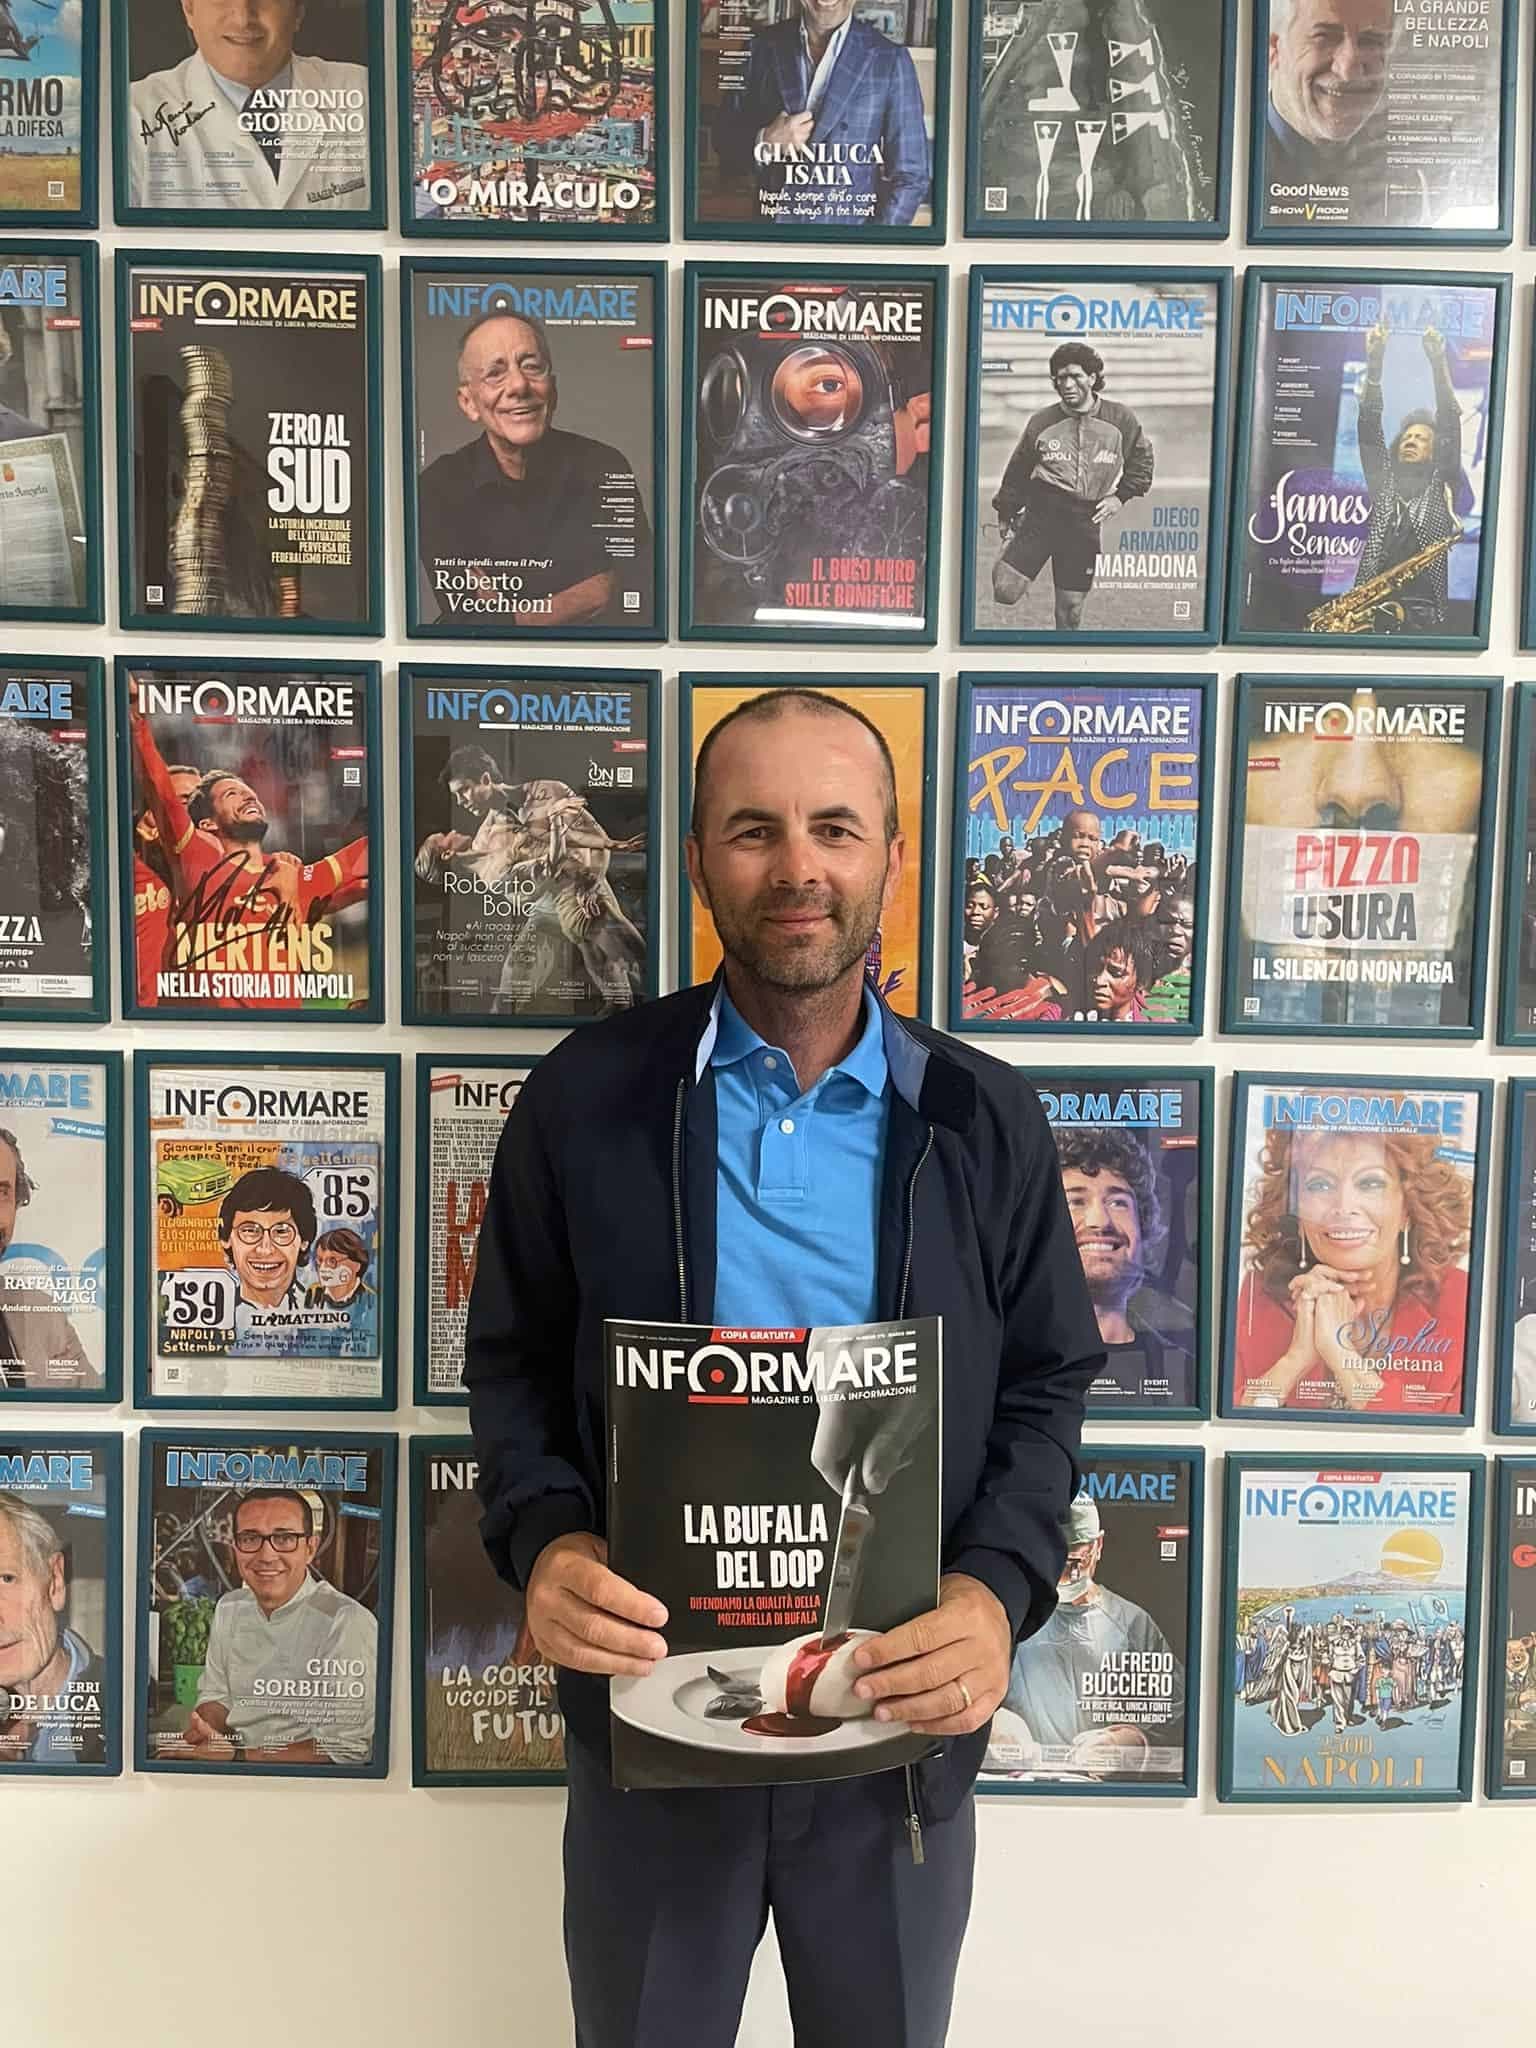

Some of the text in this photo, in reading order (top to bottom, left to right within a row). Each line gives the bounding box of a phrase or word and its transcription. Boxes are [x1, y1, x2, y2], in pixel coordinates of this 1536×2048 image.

[1394, 0, 1489, 15] LA GRANDE
[1405, 18, 1489, 32] BELLEZZA
[1413, 32, 1489, 48] È NAPOLI
[250, 88, 364, 110] ANTONIO
[21, 120, 64, 137] DIFESA
[239, 112, 365, 133] GIORDANO
[754, 143, 885, 165] GIANLUCA
[785, 165, 852, 185] ISAIA
[423, 173, 641, 209] 'O MIRÀCULO
[856, 193, 878, 203] core
[793, 203, 876, 219] always in the heart
[140, 281, 356, 320] INFORMARE
[427, 283, 637, 320] INFORMARE
[704, 294, 923, 333] INFORMARE
[991, 294, 1206, 330] INFORMARE
[1275, 293, 1488, 337] INFORMARE
[268, 412, 350, 446] ZERO AL
[268, 447, 351, 514] SUD
[1153, 507, 1200, 527] DIEGO
[1249, 470, 1372, 544] James
[269, 518, 351, 529] LA STORIA INCREDIBILE
[299, 541, 351, 553] PERVERSA DEL
[1119, 531, 1199, 551] ARMANDO
[1288, 523, 1362, 557] Senese
[272, 552, 352, 564] FEDERALISMO FISCALE
[434, 558, 456, 567] Tutti
[457, 559, 466, 567] in
[494, 560, 518, 568] entra
[520, 559, 527, 567] il
[1095, 554, 1198, 579] MARADONA
[434, 570, 523, 591] Roberto
[812, 557, 916, 583] IL BUCO NERO
[446, 593, 553, 614] Vecchioni
[785, 583, 914, 609] SULLE BONIFICHE
[0, 682, 73, 719] ARE
[138, 681, 353, 717] INFORMARE
[427, 688, 631, 724] INFORMARE
[585, 725, 631, 733] INFORMAZIONE
[976, 700, 1191, 736] INFORMARE
[1264, 702, 1466, 736] INFORMARE
[968, 746, 1199, 833] RACE
[1295, 835, 1421, 889] PIZZO
[443, 872, 536, 895] Roberto
[483, 895, 537, 917] Bolle
[1292, 892, 1417, 941] USURA
[176, 921, 333, 973] MERTENS
[433, 953, 452, 961] non
[1252, 958, 1454, 984] IL SILENZIO NON PAGA
[157, 973, 354, 999] NELLA STORIA DI NAPOLI
[165, 1086, 368, 1117] INFORMARE
[1264, 1094, 1464, 1135] INFORMARE
[162, 1153, 180, 1162] che
[4, 1276, 97, 1291] RAFFAELLO
[52, 1290, 97, 1304] MAGI
[167, 1272, 225, 1325] '59
[252, 1312, 350, 1326] IL MATTINO
[170, 1328, 235, 1340] NAPOLI 19
[721, 1330, 795, 1341] COPIA GRATUITA
[1335, 1308, 1455, 1360] Sophia
[164, 1341, 231, 1353] Settembre
[615, 1342, 918, 1393] INFORMARE
[1342, 1353, 1444, 1375] napoletana
[752, 1385, 917, 1405] MAGAZINE DI LIBERA INFORMAZIONE
[1299, 1380, 1336, 1389] AMBIENTE
[0, 1455, 93, 1490] MARE
[166, 1451, 367, 1491] INFORMARE
[1323, 1474, 1343, 1482] COPIA
[286, 1482, 321, 1490] CULTURALE
[1246, 1485, 1456, 1518] INFORMARE
[684, 1504, 829, 1544] LA BUFALA
[716, 1549, 824, 1589] DEL DOP
[690, 1593, 821, 1610] DIFENDIAMO LA QUALITÀ DELLA
[717, 1612, 817, 1627] MOZZARELLA DI BUFALA
[306, 1658, 366, 1677] GINO
[1100, 1651, 1173, 1673] ALFREDO
[68, 1681, 100, 1693] ERRI
[442, 1665, 472, 1687] LA
[1082, 1673, 1172, 1697] BUCCIERO
[253, 1679, 366, 1699] SORBILLO
[446, 1689, 547, 1706] UCCIDE IL
[10, 1695, 100, 1711] DE LUCA
[1126, 1702, 1148, 1712] UNICA
[1149, 1702, 1172, 1712] FONTE
[472, 1710, 566, 1745] FUTU
[1093, 1713, 1140, 1723] DEI MIRACOLI
[1260, 1757, 1424, 1787] NAPOLI
